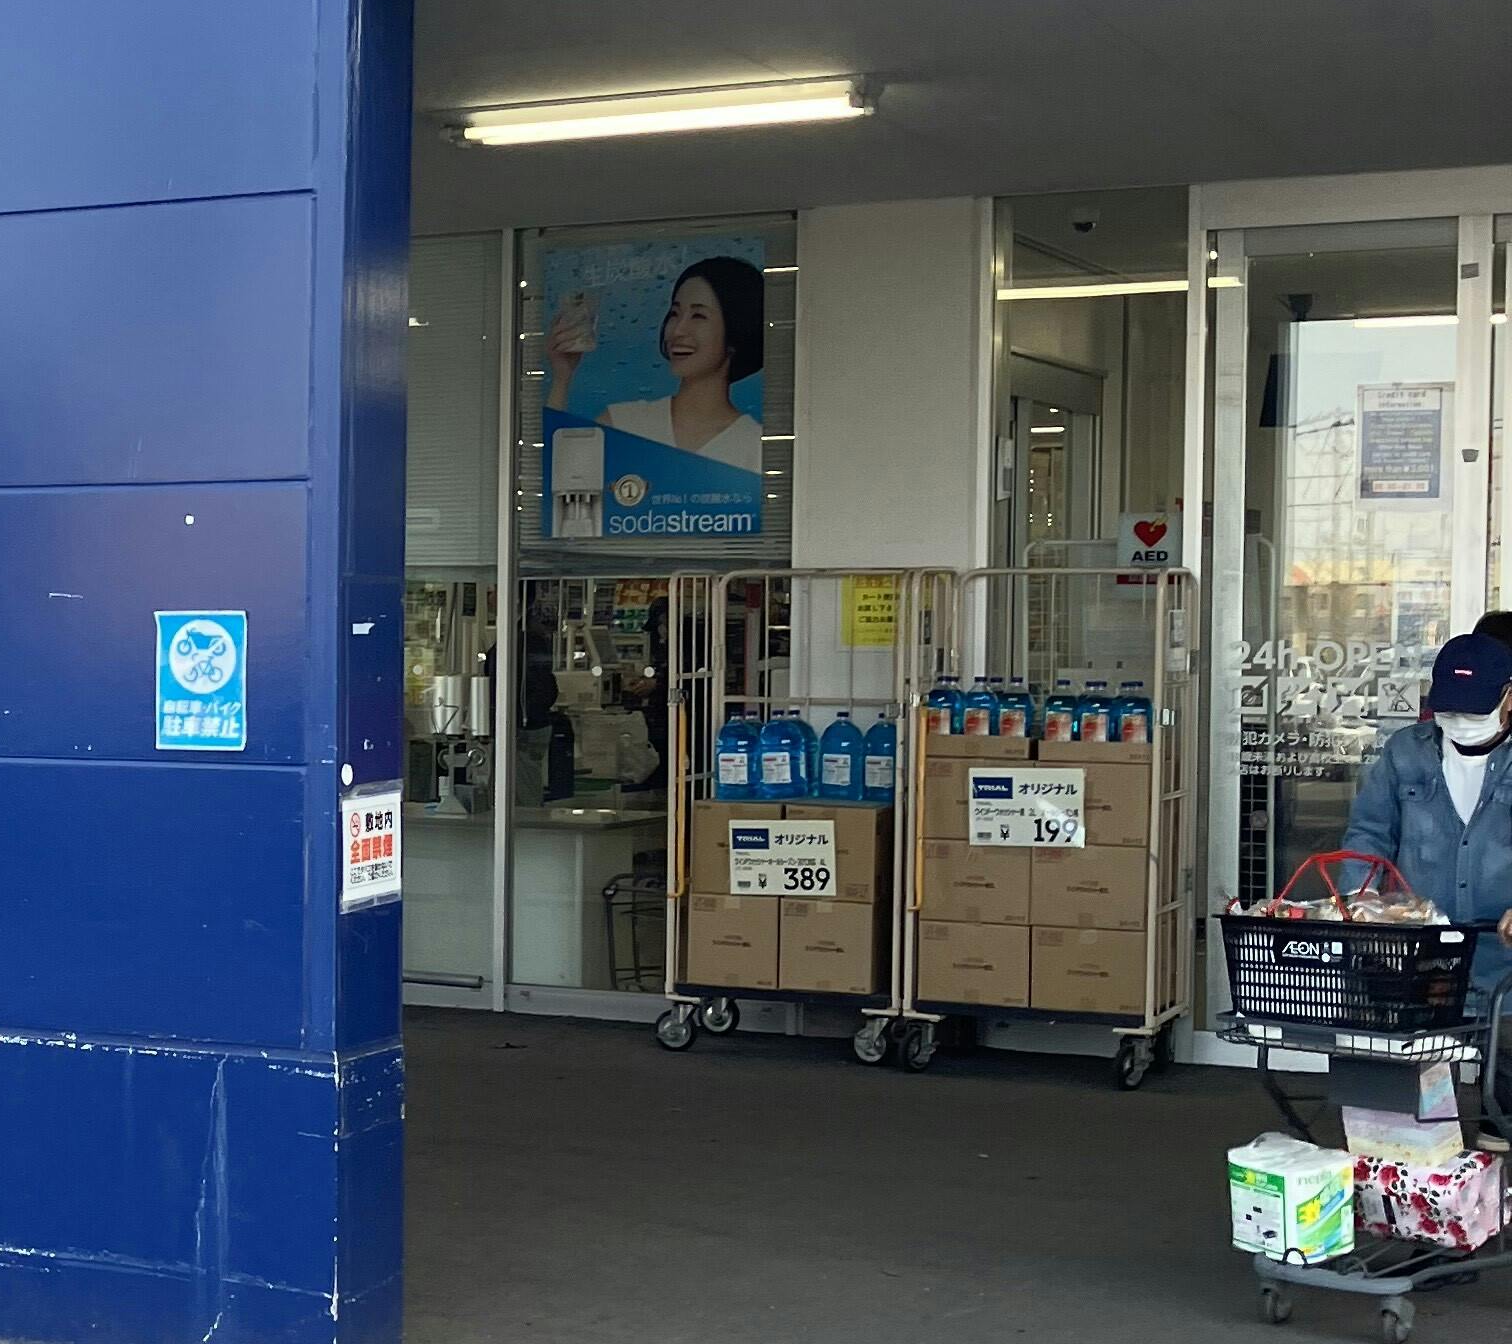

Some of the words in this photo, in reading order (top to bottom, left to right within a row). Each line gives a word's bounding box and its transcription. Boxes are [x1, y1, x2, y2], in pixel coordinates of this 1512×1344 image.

[608, 509, 752, 534] sodastream
[1131, 550, 1169, 562] AED
[1230, 640, 1299, 670] 24h
[162, 715, 241, 738] 駐車禁止
[1018, 783, 1078, 795] オリジナル
[774, 833, 829, 846] オリジナル
[1033, 818, 1079, 843] 199
[350, 834, 393, 864] 全面禁煙
[784, 867, 831, 891] 389
